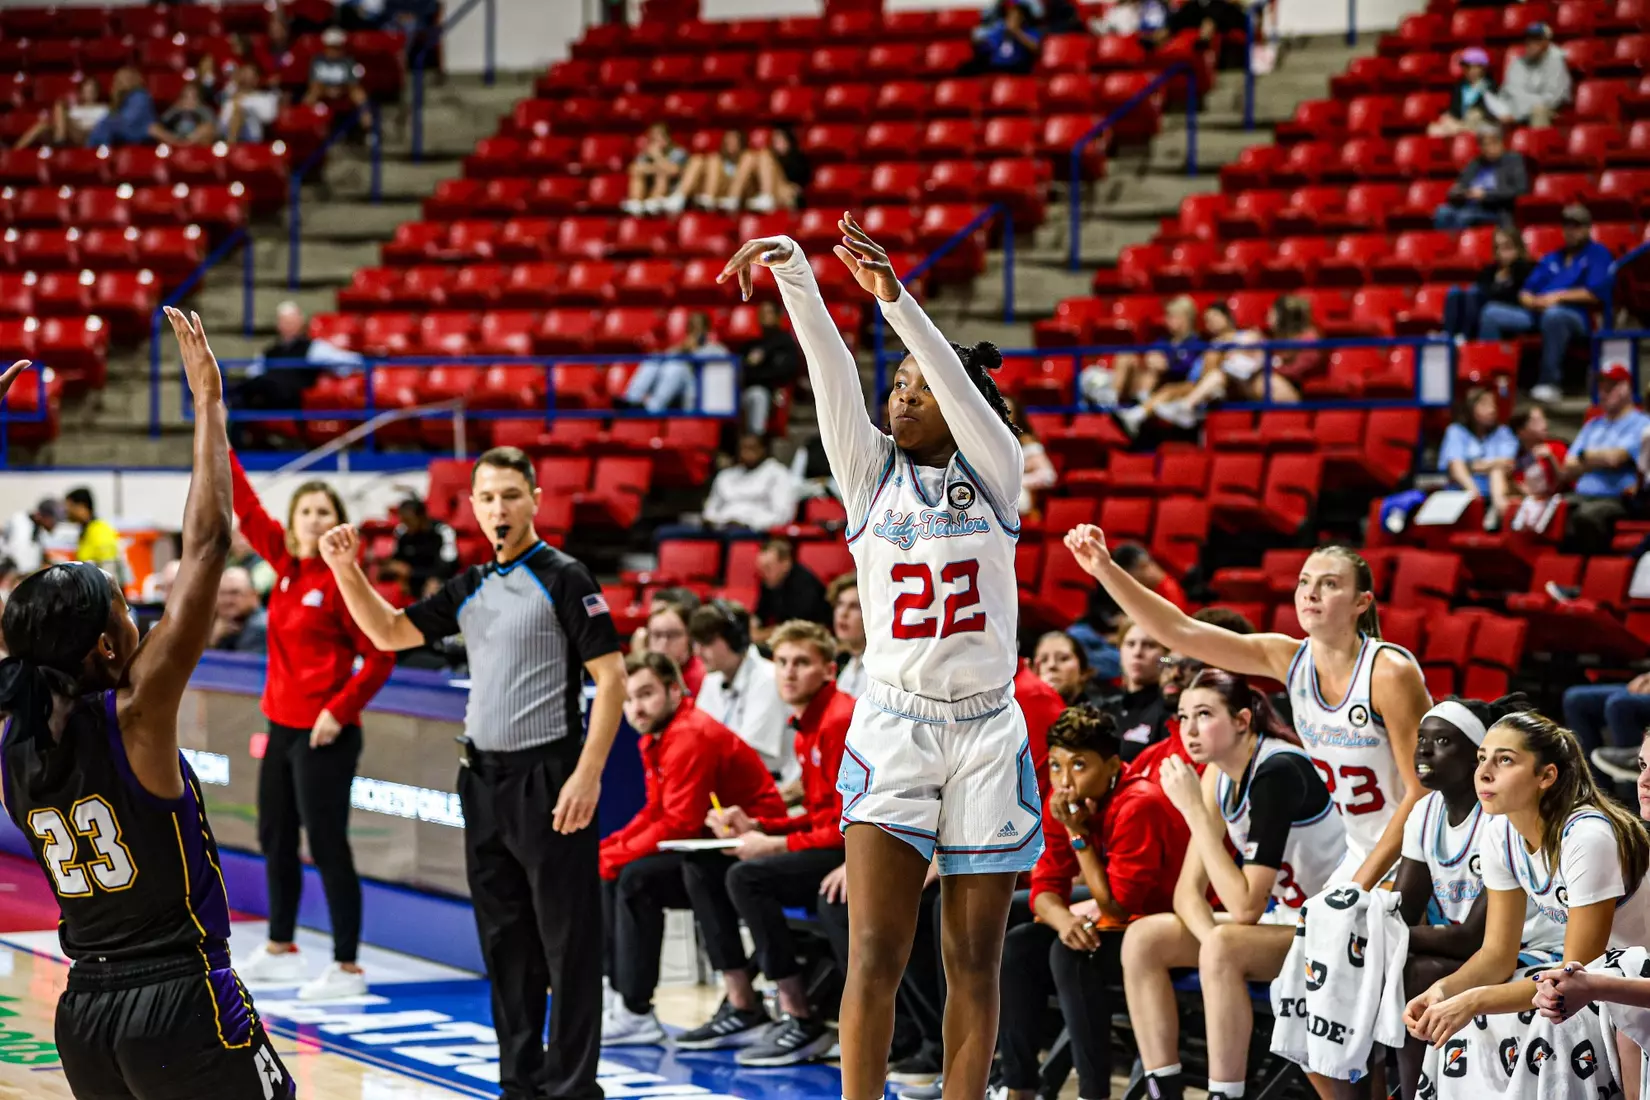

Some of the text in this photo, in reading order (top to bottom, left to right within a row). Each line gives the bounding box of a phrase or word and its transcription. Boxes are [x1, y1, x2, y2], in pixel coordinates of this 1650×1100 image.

[873, 508, 917, 551] Lady
[890, 558, 987, 640] 22
[27, 793, 139, 898] 23
